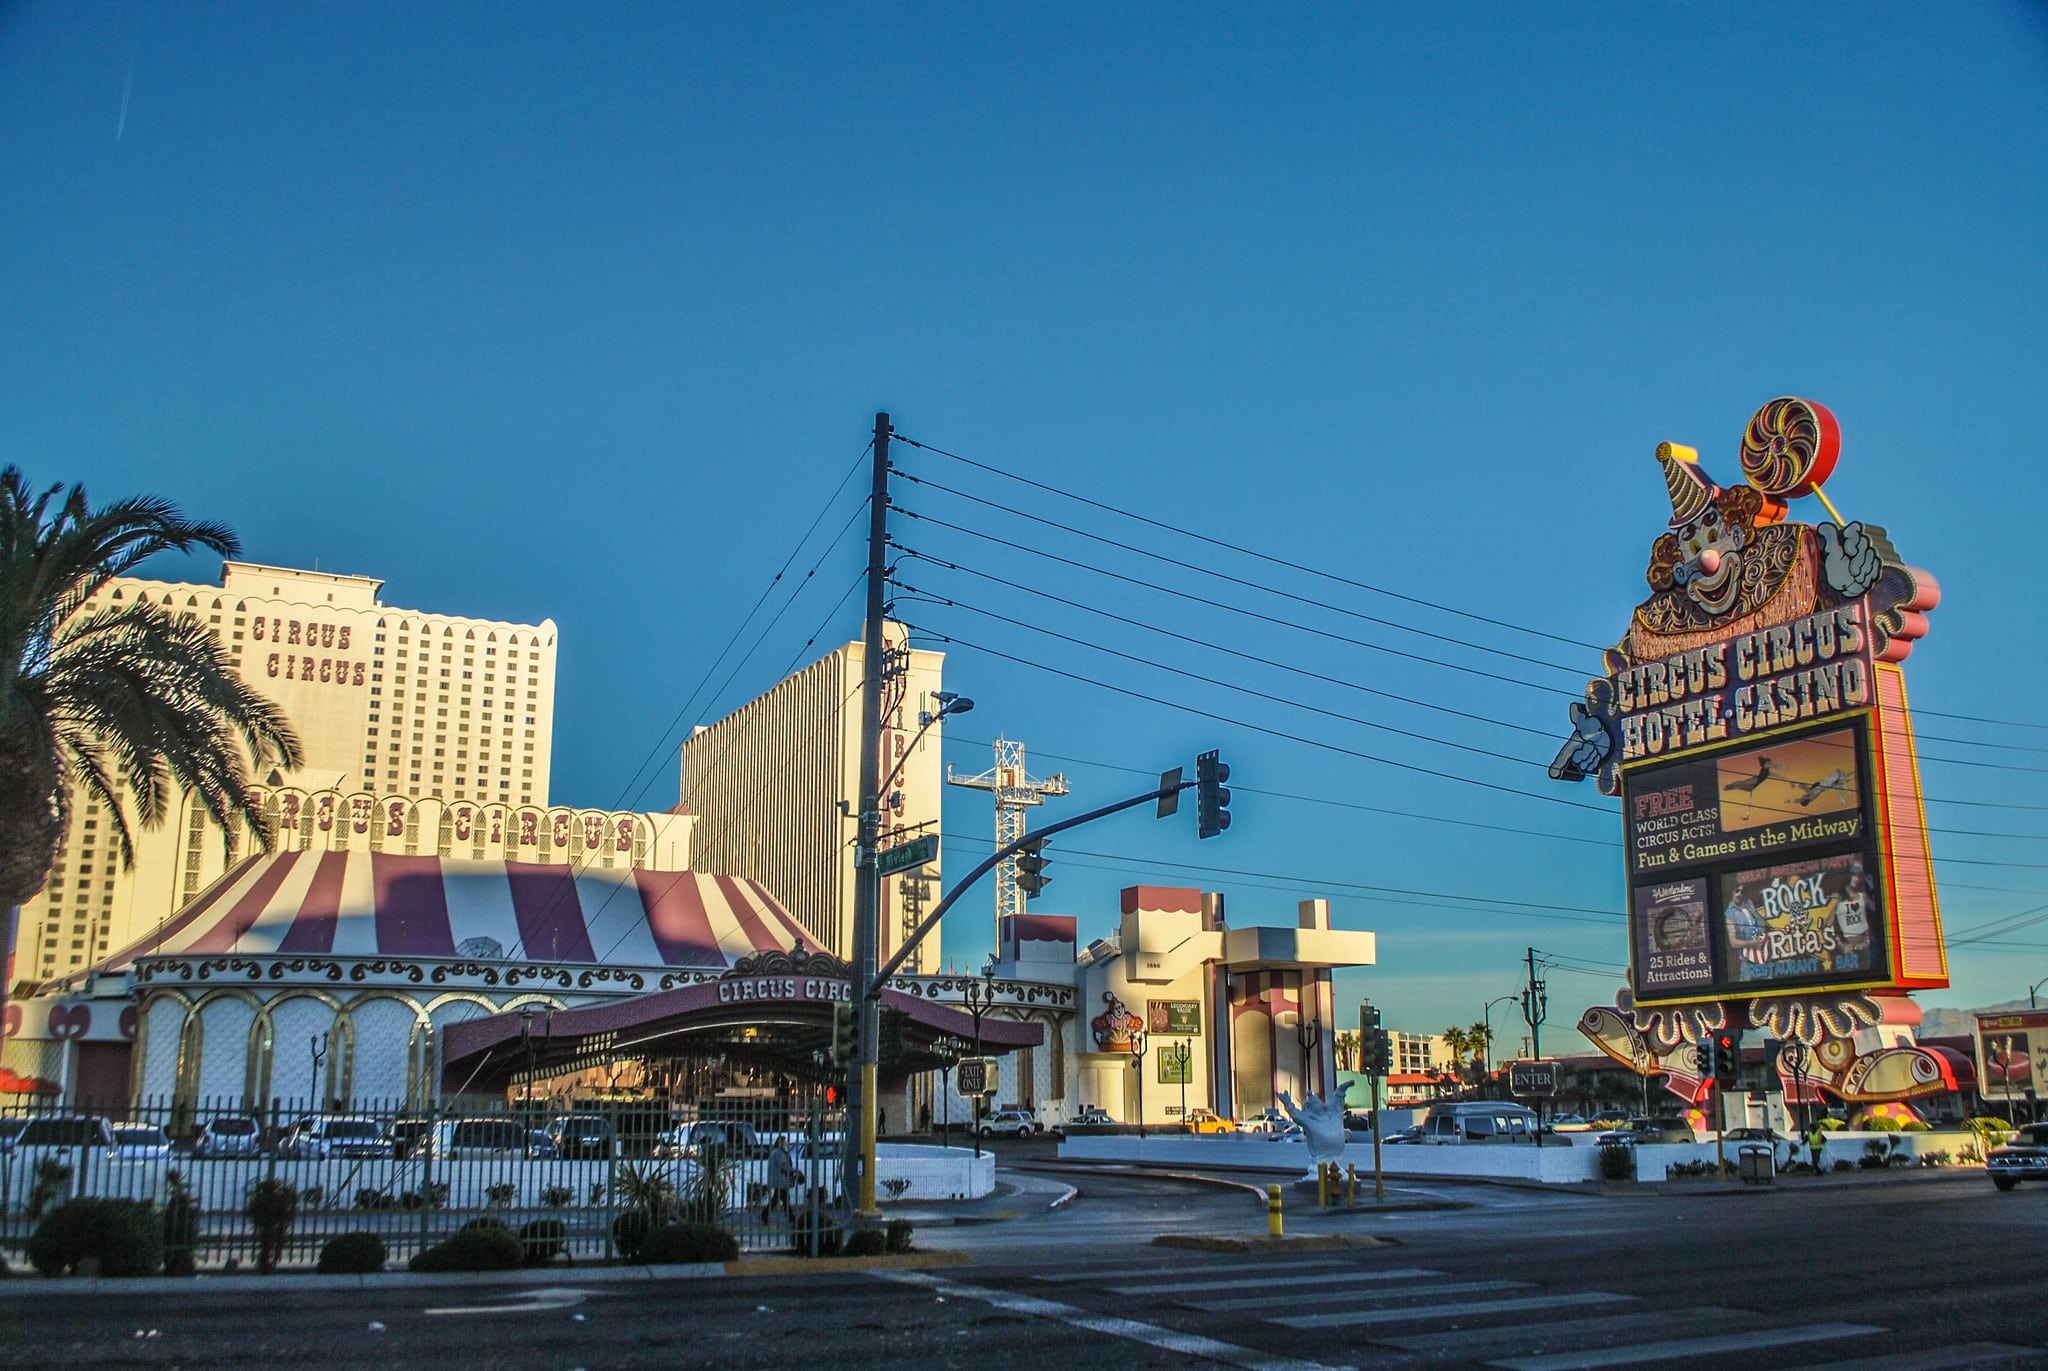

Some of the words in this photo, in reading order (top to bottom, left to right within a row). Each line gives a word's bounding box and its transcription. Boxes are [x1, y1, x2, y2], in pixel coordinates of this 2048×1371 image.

[252, 616, 351, 649] CIRCUS
[267, 653, 365, 686] CIRCUS
[1617, 642, 1728, 713] CIRCUS
[1736, 603, 1865, 681] CIRCUS
[1621, 694, 1728, 760] HOTEL
[1734, 658, 1868, 732] CASINO
[1634, 785, 1694, 819] FREE
[455, 807, 632, 851] CIRCUS
[1636, 816, 1678, 834] WORLD
[1680, 807, 1718, 825] CLASS
[1637, 831, 1679, 848] CIRCUS
[1681, 824, 1716, 841] ACTS!
[1638, 852, 1666, 868] Fun
[1669, 847, 1680, 863] &
[1684, 838, 1736, 859] Games
[1740, 835, 1756, 851] at
[1760, 829, 1787, 847] the
[1760, 873, 1828, 920] ROCK
[1768, 918, 1837, 961] Rita's
[1647, 965, 1713, 983] Attractions!
[1650, 956, 1664, 969] 25
[1666, 953, 1696, 967] Rides
[1698, 951, 1707, 964] &
[1836, 954, 1860, 969] BAR
[719, 979, 796, 1002] CIRCUS
[805, 979, 851, 1001] CIRC
[962, 1078, 981, 1089] ONLY
[964, 1066, 980, 1077] EXIT
[1515, 1073, 1551, 1085] ENTER
